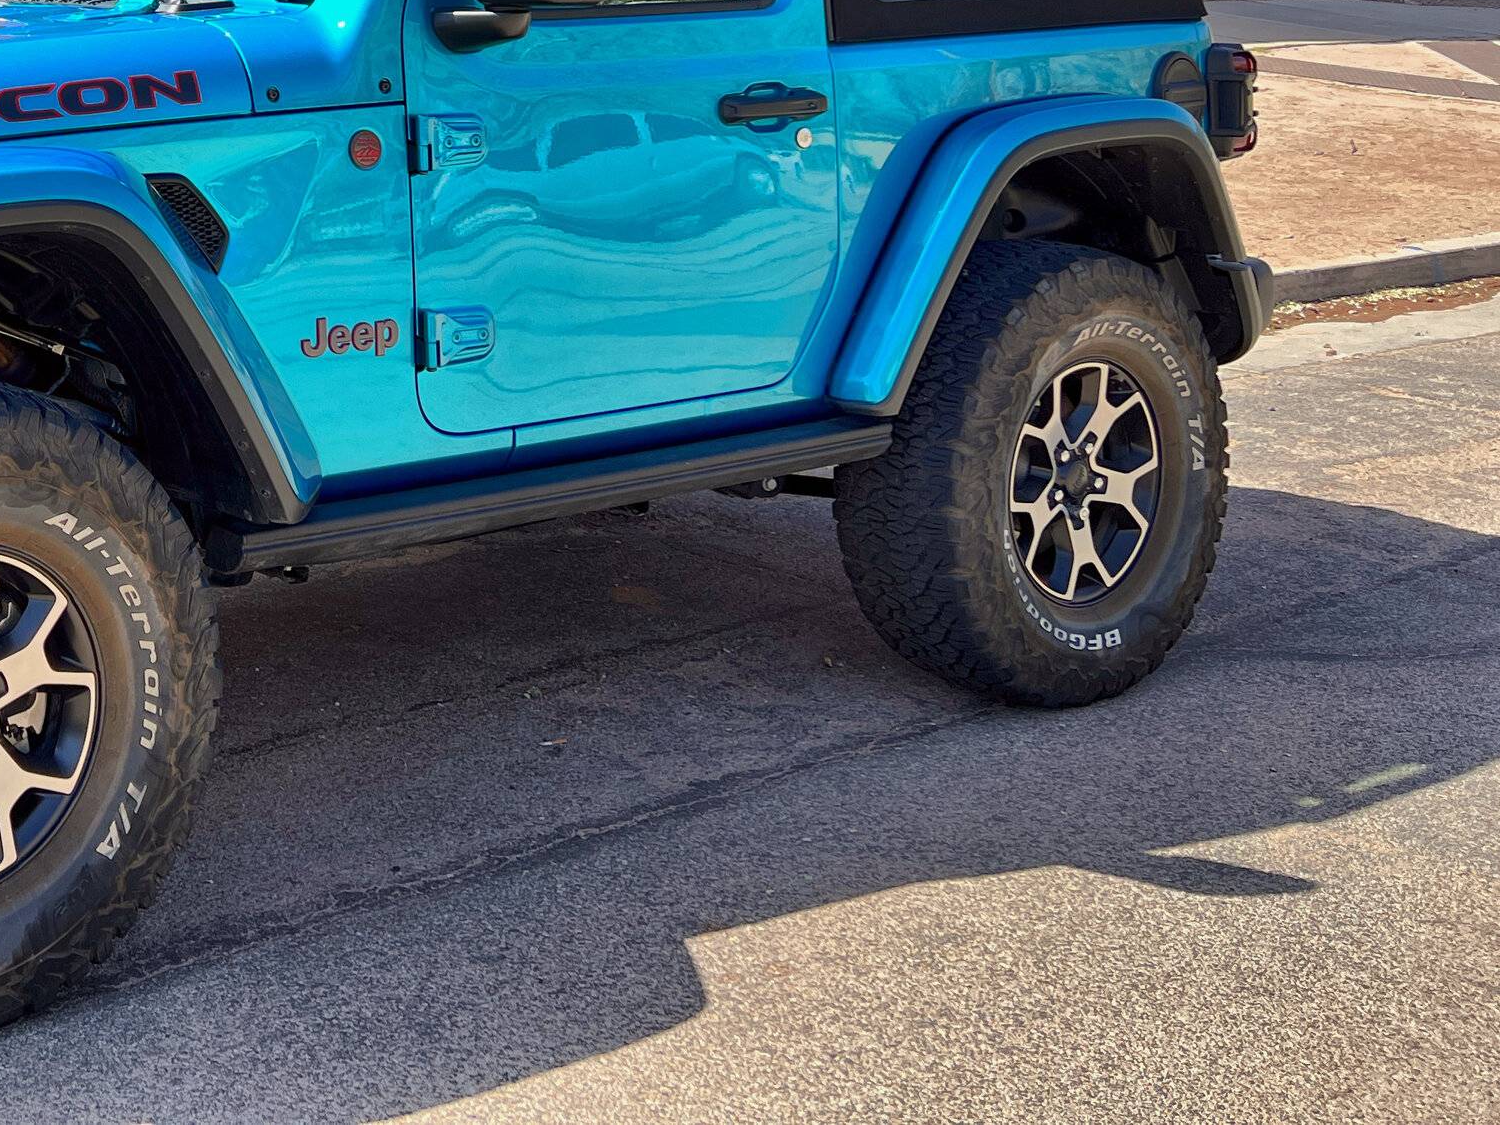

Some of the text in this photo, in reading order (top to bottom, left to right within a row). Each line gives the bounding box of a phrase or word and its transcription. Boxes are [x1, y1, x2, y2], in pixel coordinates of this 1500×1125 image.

[300, 317, 399, 358] Jeep
[1072, 321, 1205, 471] All-Terrain T/A
[1003, 529, 1122, 651] BFGoodrich
[43, 511, 162, 860] All-Terrain T/A
